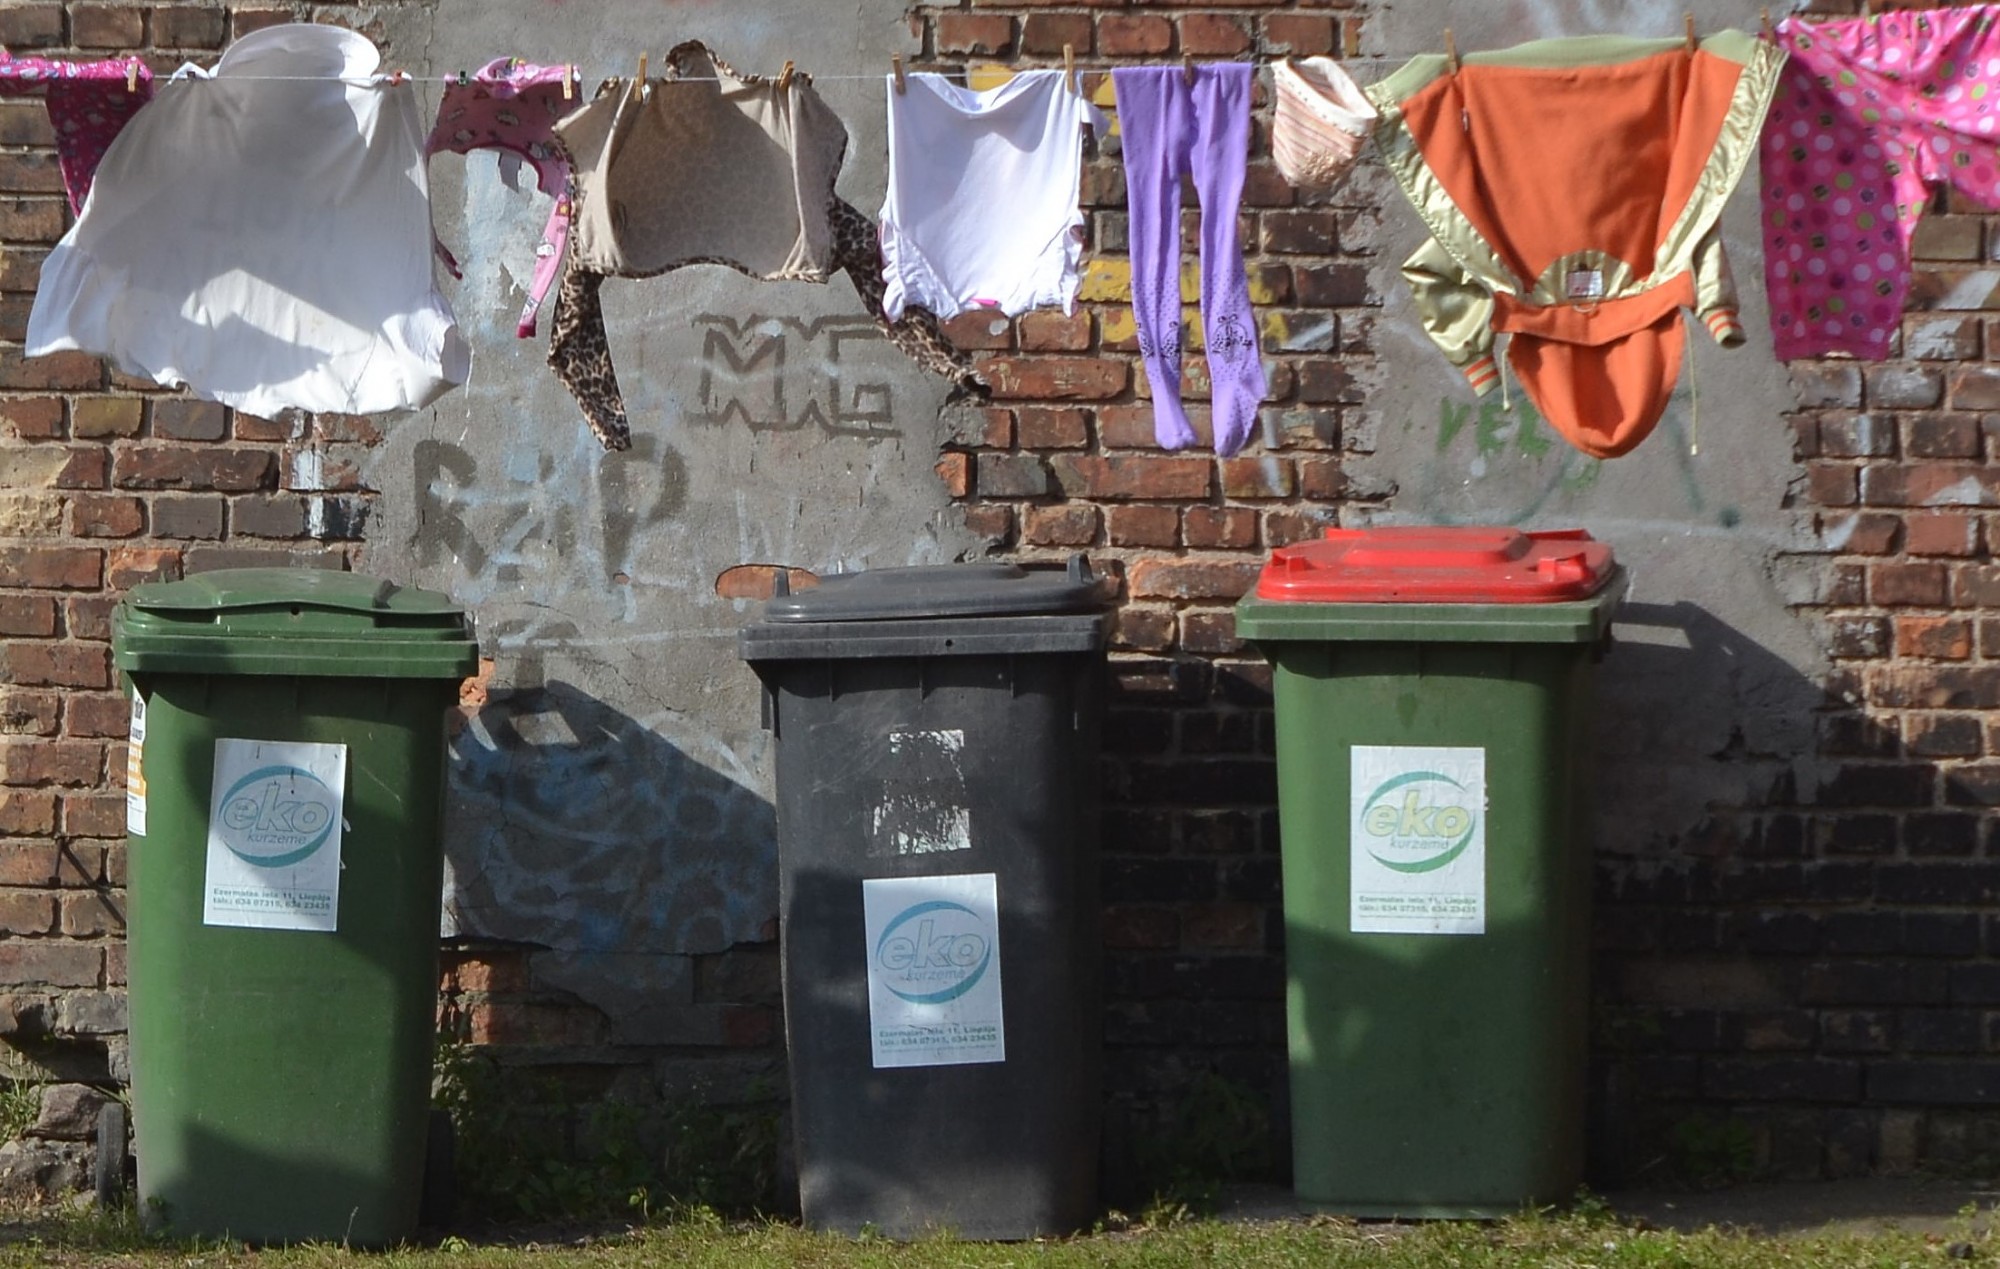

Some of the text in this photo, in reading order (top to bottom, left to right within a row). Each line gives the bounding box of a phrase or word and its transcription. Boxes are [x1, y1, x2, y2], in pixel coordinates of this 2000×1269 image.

[223, 783, 329, 834] eko
[1365, 789, 1470, 839] eko
[247, 832, 308, 845] kurzeme
[881, 919, 985, 970] eko
